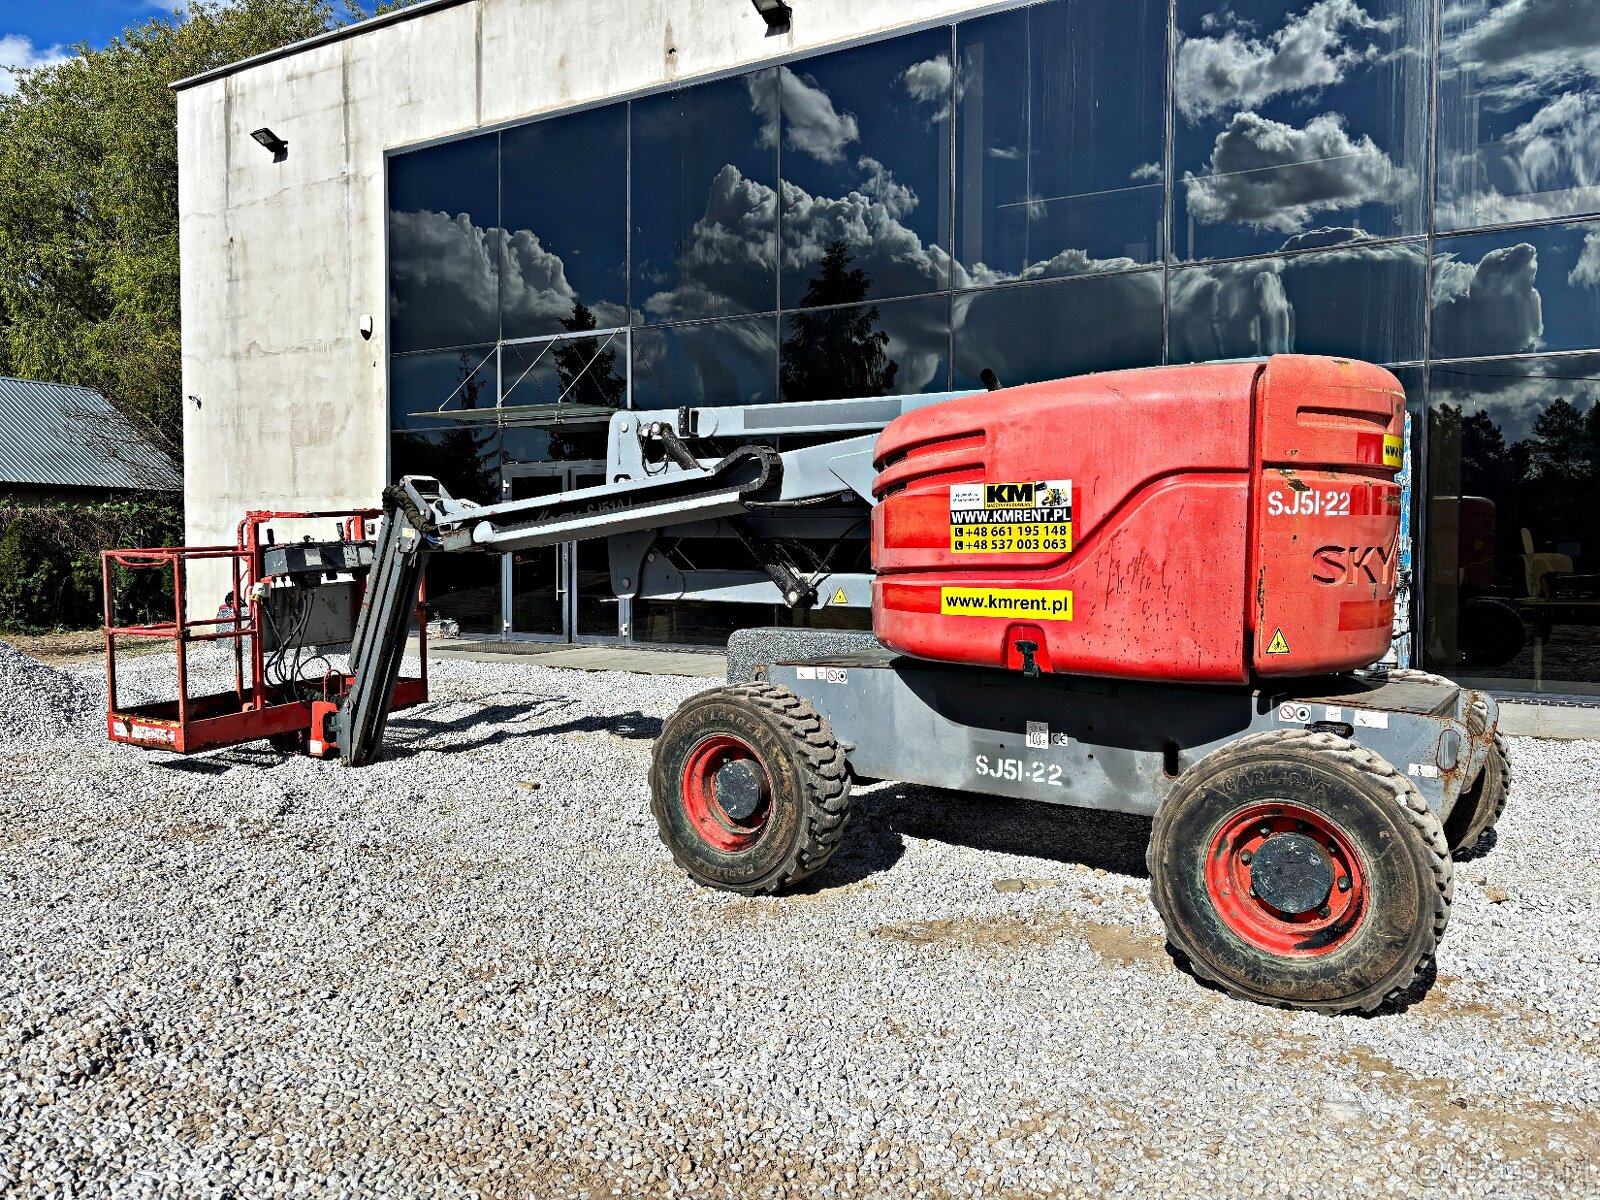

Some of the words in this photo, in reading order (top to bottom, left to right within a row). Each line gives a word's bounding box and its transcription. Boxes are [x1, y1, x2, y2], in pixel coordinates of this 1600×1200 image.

[986, 483, 1033, 503] KM
[951, 508, 1071, 524] WWW.KMRENT.PL
[966, 526, 988, 537] +48
[991, 526, 1012, 537] 661
[1017, 526, 1039, 536] 195
[1044, 525, 1067, 536] 148
[966, 540, 988, 550] +48
[991, 539, 1013, 550] 537
[1017, 539, 1039, 550] 003
[1043, 538, 1067, 549] 063
[946, 594, 1068, 615] www.kmrent.pl
